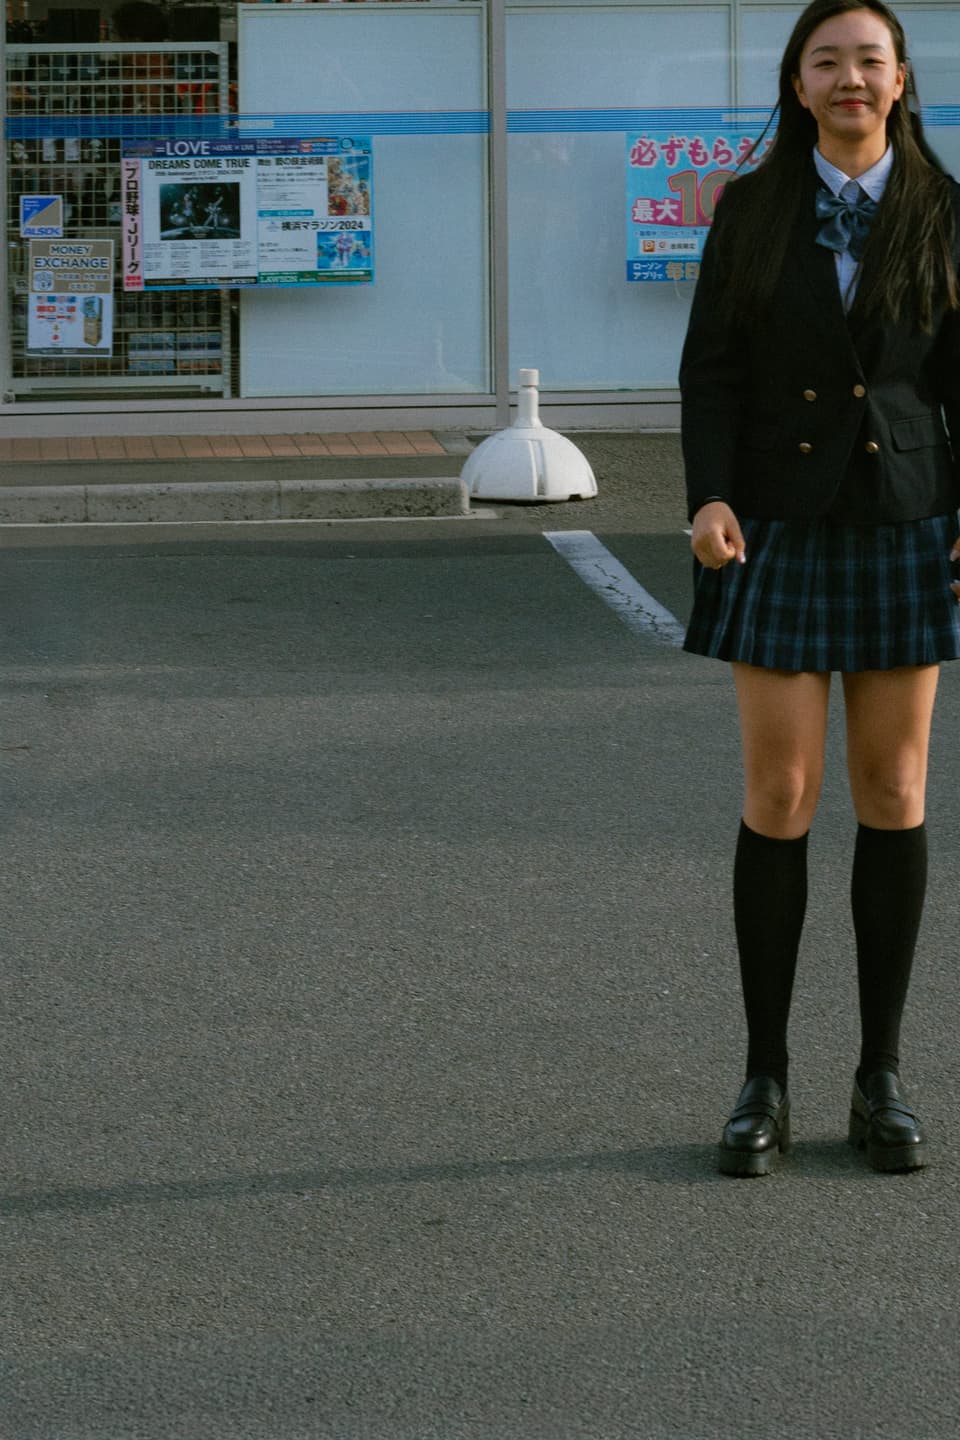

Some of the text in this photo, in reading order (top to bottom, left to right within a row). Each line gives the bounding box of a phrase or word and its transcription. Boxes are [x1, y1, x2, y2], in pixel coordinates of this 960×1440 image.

[630, 136, 775, 166] 必ずもらえ
[148, 159, 191, 170] DREAMS
[193, 159, 222, 169] COME
[225, 158, 250, 168] TRUE
[633, 198, 678, 222] 最大
[23, 227, 60, 235] ALSOK
[281, 220, 364, 231] 横浜マラソン2024
[51, 245, 90, 255] MONEY
[34, 257, 109, 268] EXCHANGE
[633, 262, 663, 270] ローソン
